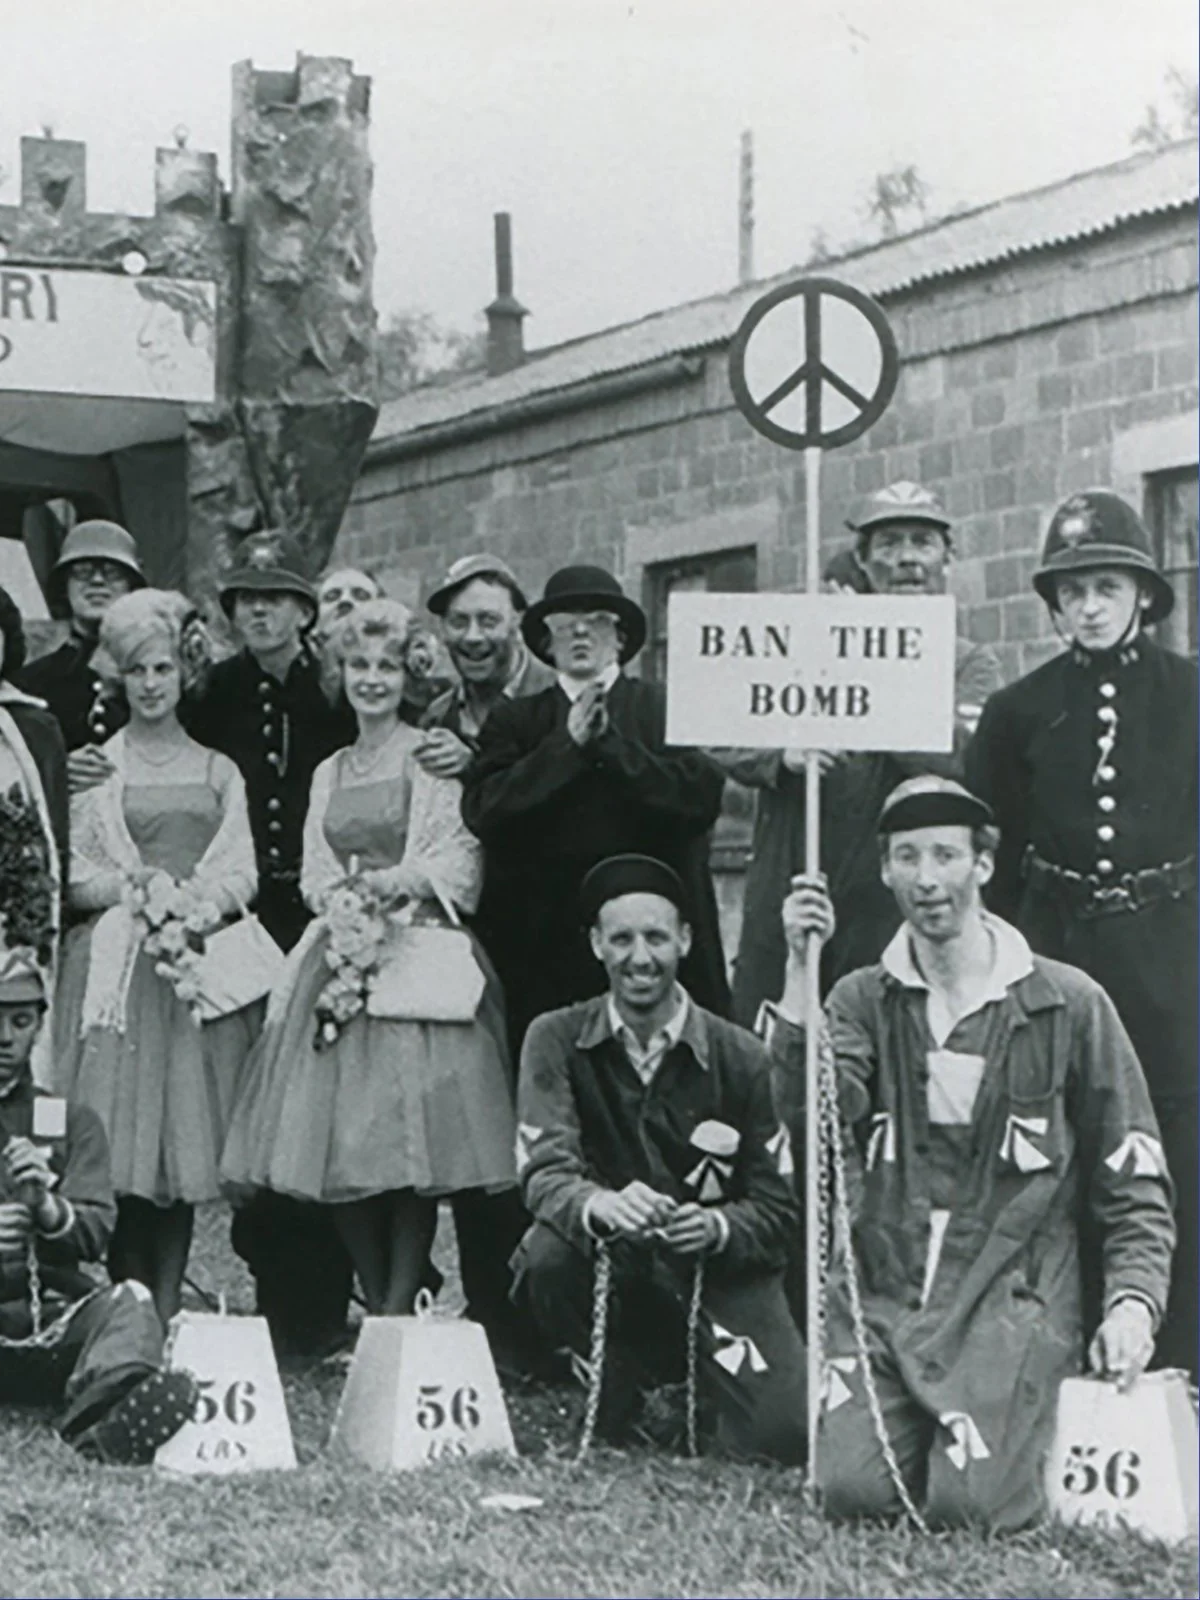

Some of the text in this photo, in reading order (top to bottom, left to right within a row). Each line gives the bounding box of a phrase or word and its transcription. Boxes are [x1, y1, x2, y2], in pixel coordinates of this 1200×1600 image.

[699, 624, 923, 660] BAN THE
[749, 683, 870, 717] BOMB
[194, 1380, 256, 1425] 56
[415, 1385, 480, 1431] 56
[1062, 1445, 1141, 1499] 56
